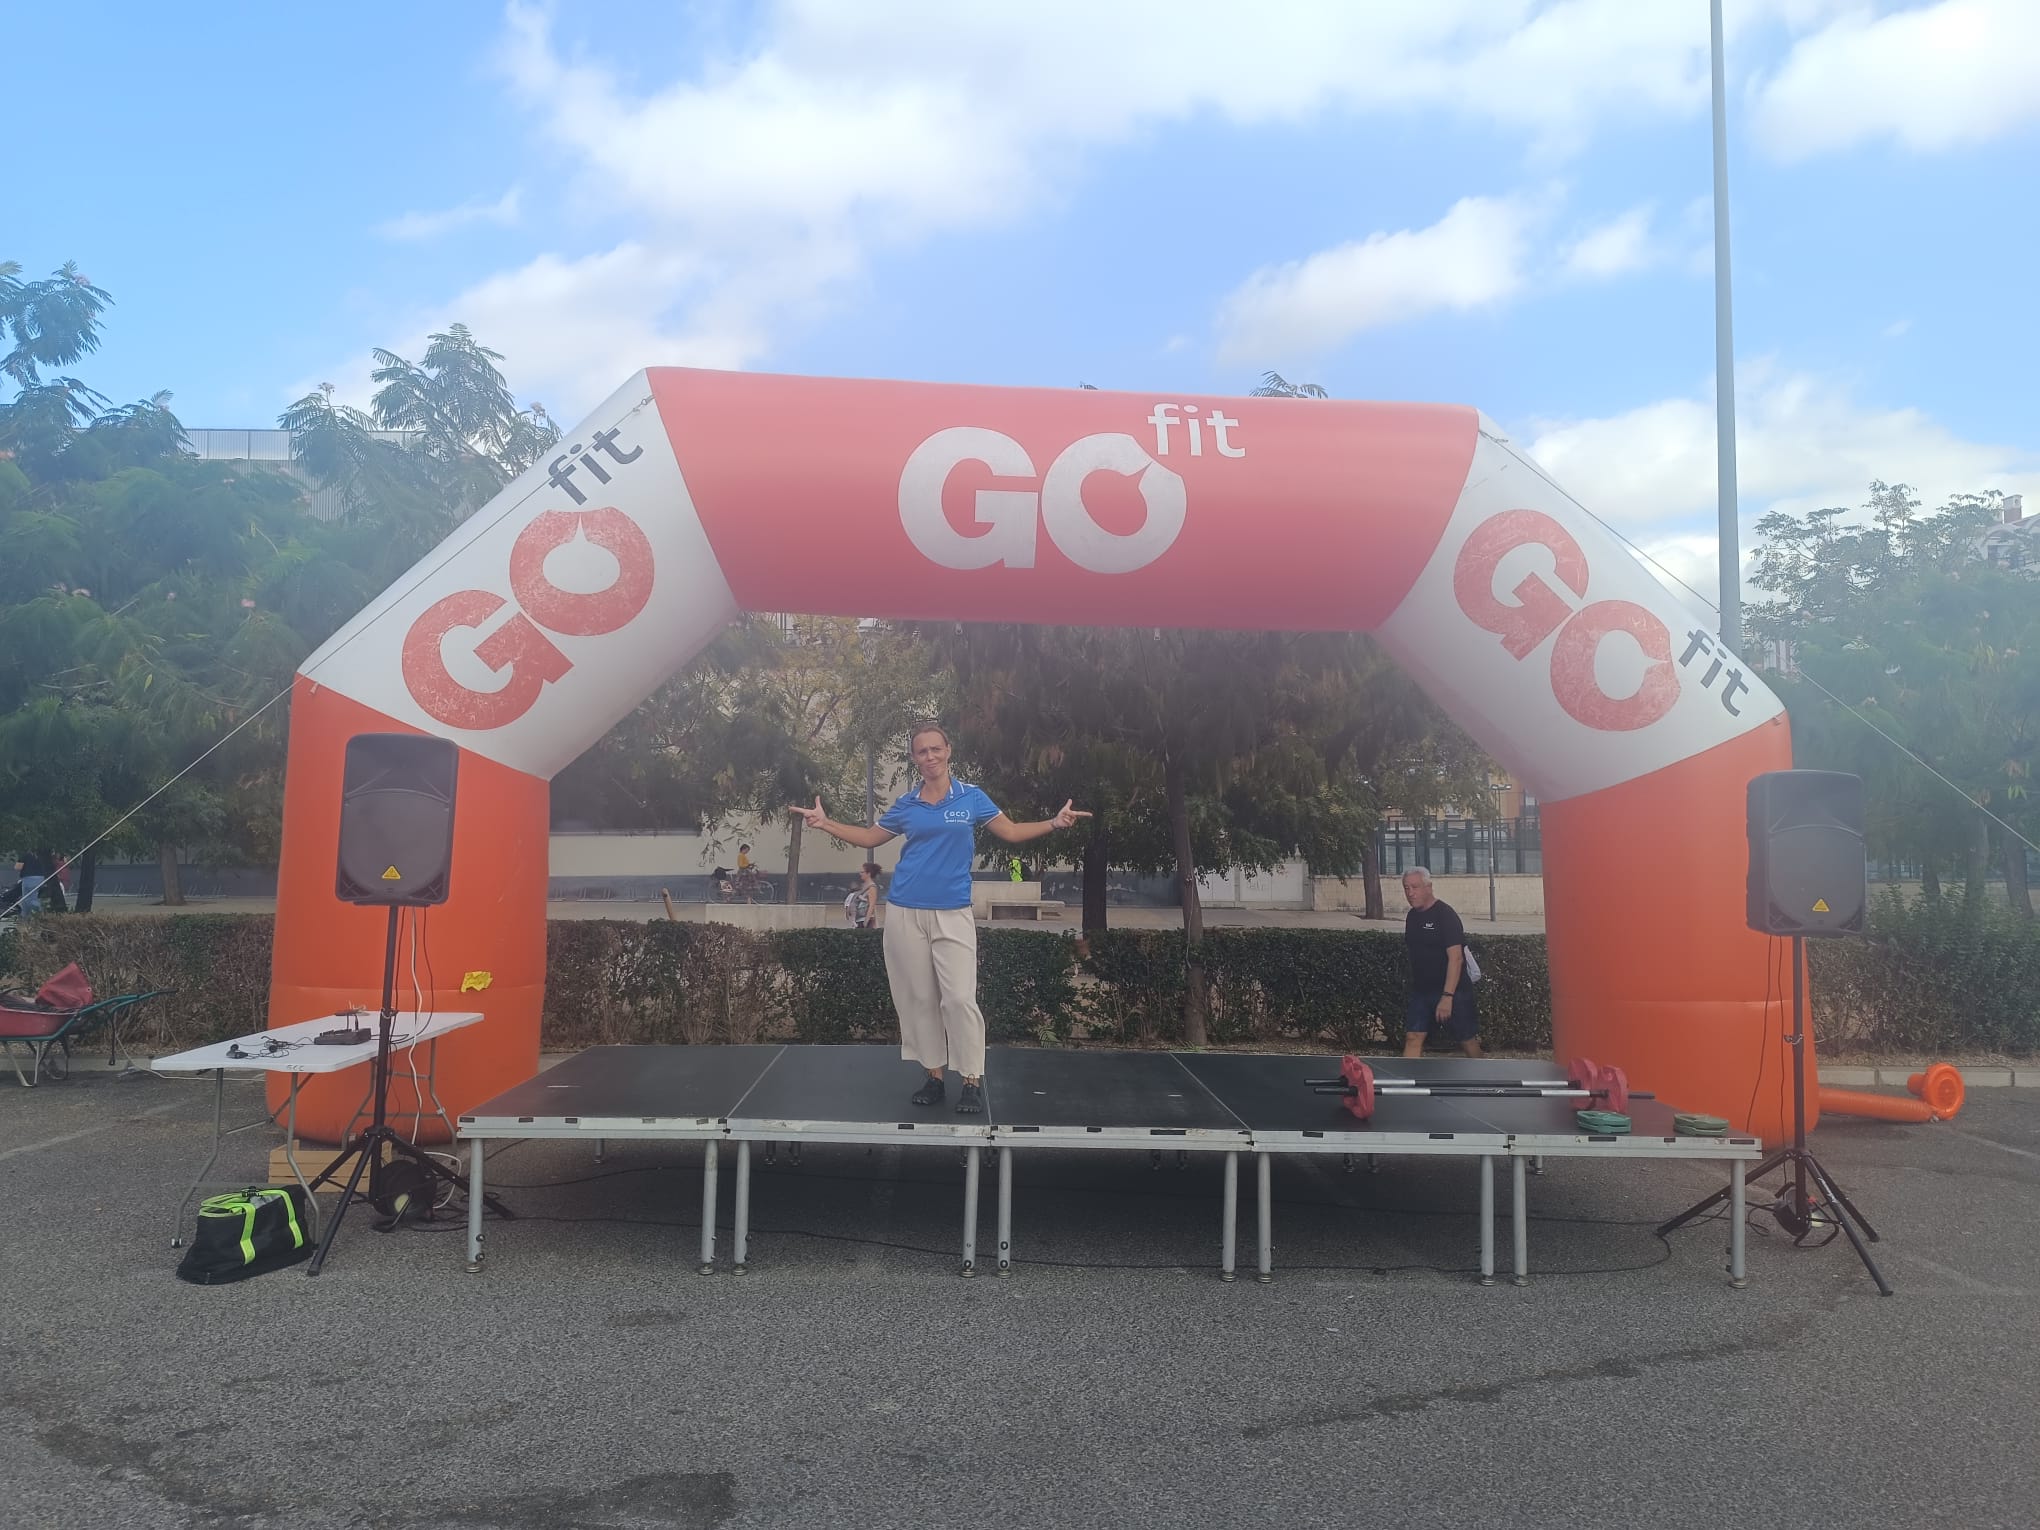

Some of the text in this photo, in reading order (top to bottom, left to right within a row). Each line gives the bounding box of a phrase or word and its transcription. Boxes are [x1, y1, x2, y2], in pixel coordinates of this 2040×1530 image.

[402, 428, 655, 731] GO fit
[898, 403, 1246, 574] GO fit
[1453, 509, 1750, 732] GO fit
